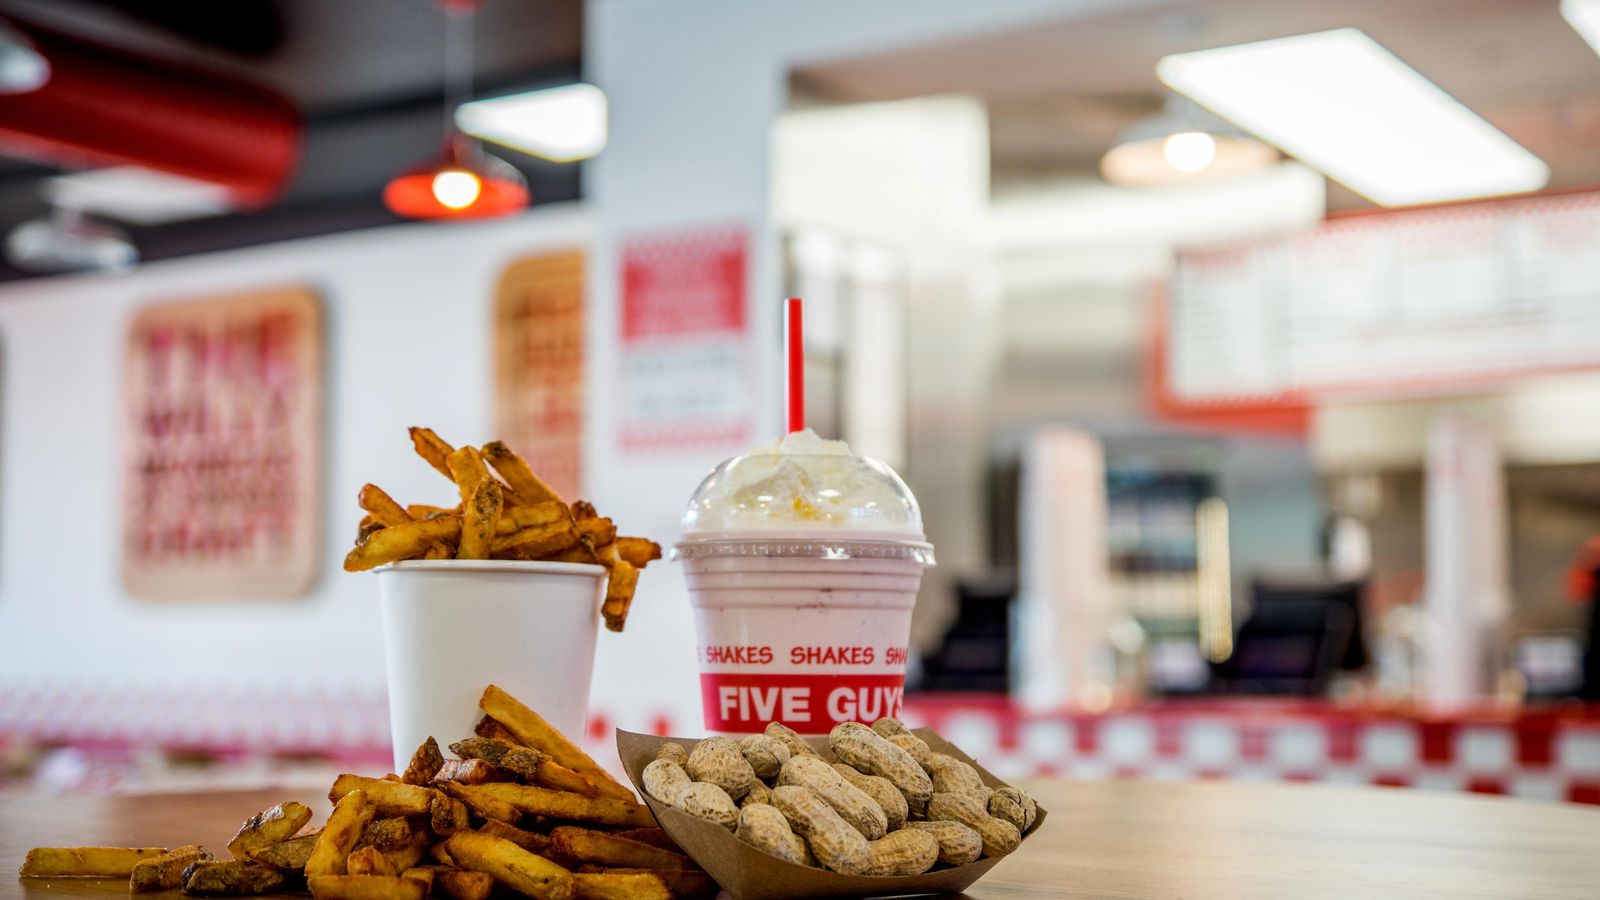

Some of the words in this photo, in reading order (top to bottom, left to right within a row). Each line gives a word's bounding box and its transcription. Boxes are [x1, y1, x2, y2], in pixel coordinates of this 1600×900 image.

[707, 645, 774, 665] SHAKES
[790, 646, 875, 665] SHAKES
[719, 686, 811, 722] FIVE
